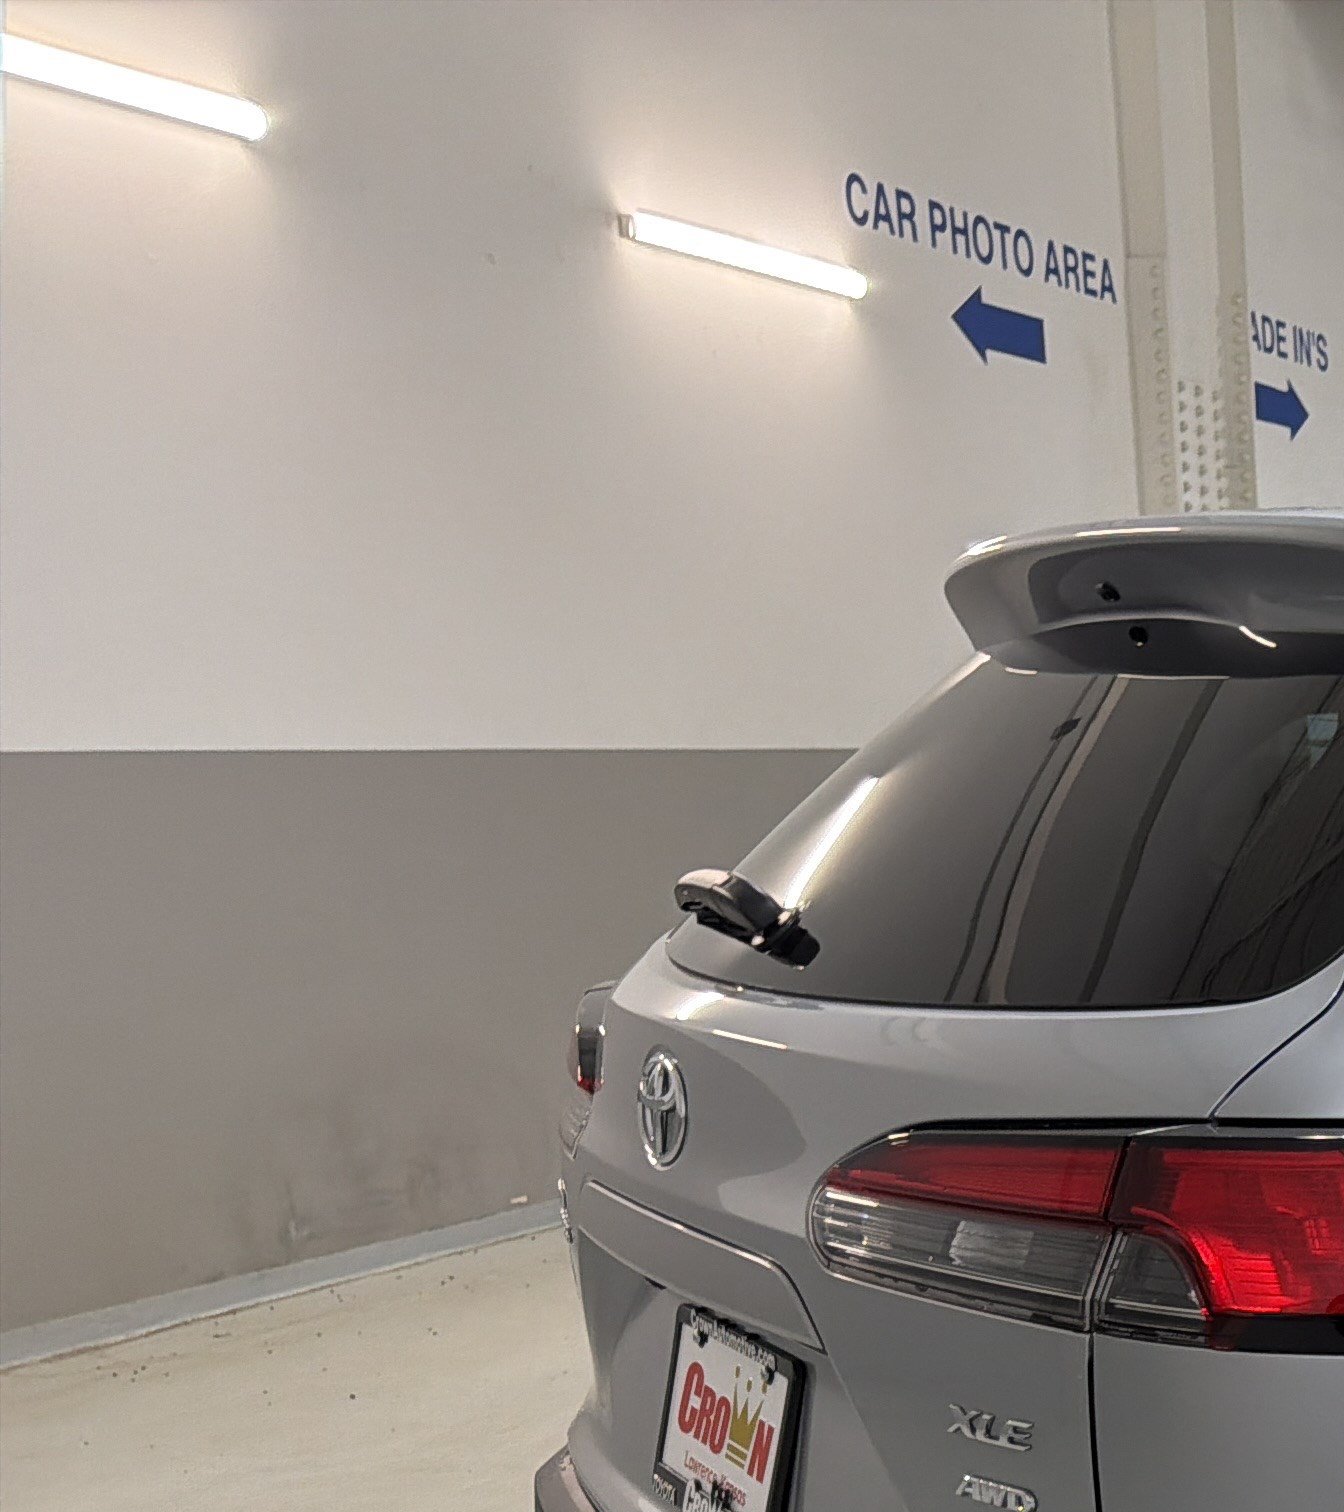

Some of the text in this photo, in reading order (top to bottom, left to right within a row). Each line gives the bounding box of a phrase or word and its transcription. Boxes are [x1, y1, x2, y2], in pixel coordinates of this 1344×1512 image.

[845, 172, 1117, 305] CAR PHOTO AREA
[1292, 323, 1329, 373] IN'S
[946, 1403, 1035, 1452] XLE
